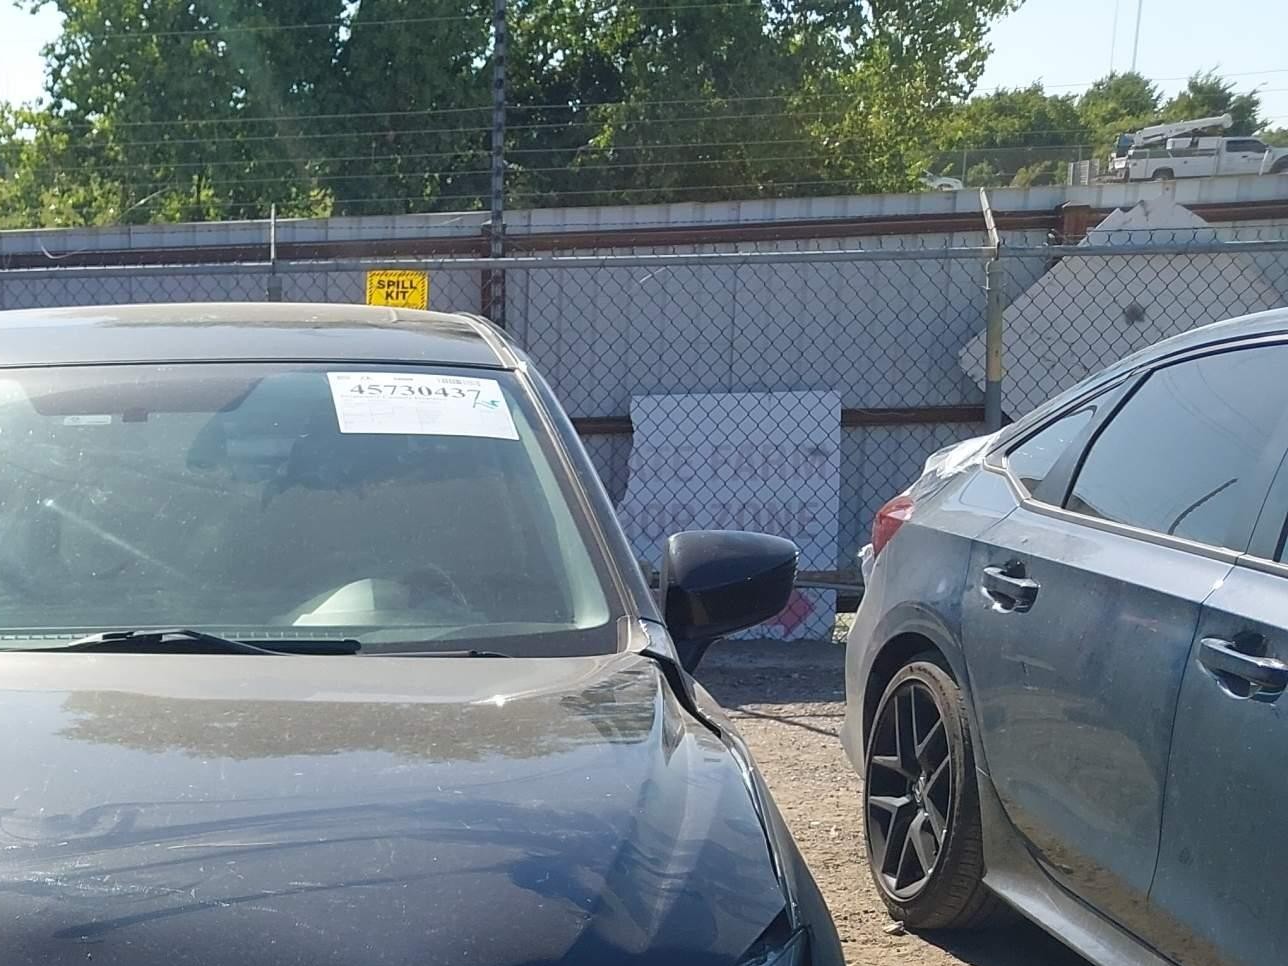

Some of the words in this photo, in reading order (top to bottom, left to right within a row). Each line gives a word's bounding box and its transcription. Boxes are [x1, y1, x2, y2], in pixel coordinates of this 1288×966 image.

[377, 279, 417, 290] SPILL
[385, 291, 409, 301] KIT
[349, 384, 481, 402] 45730437
